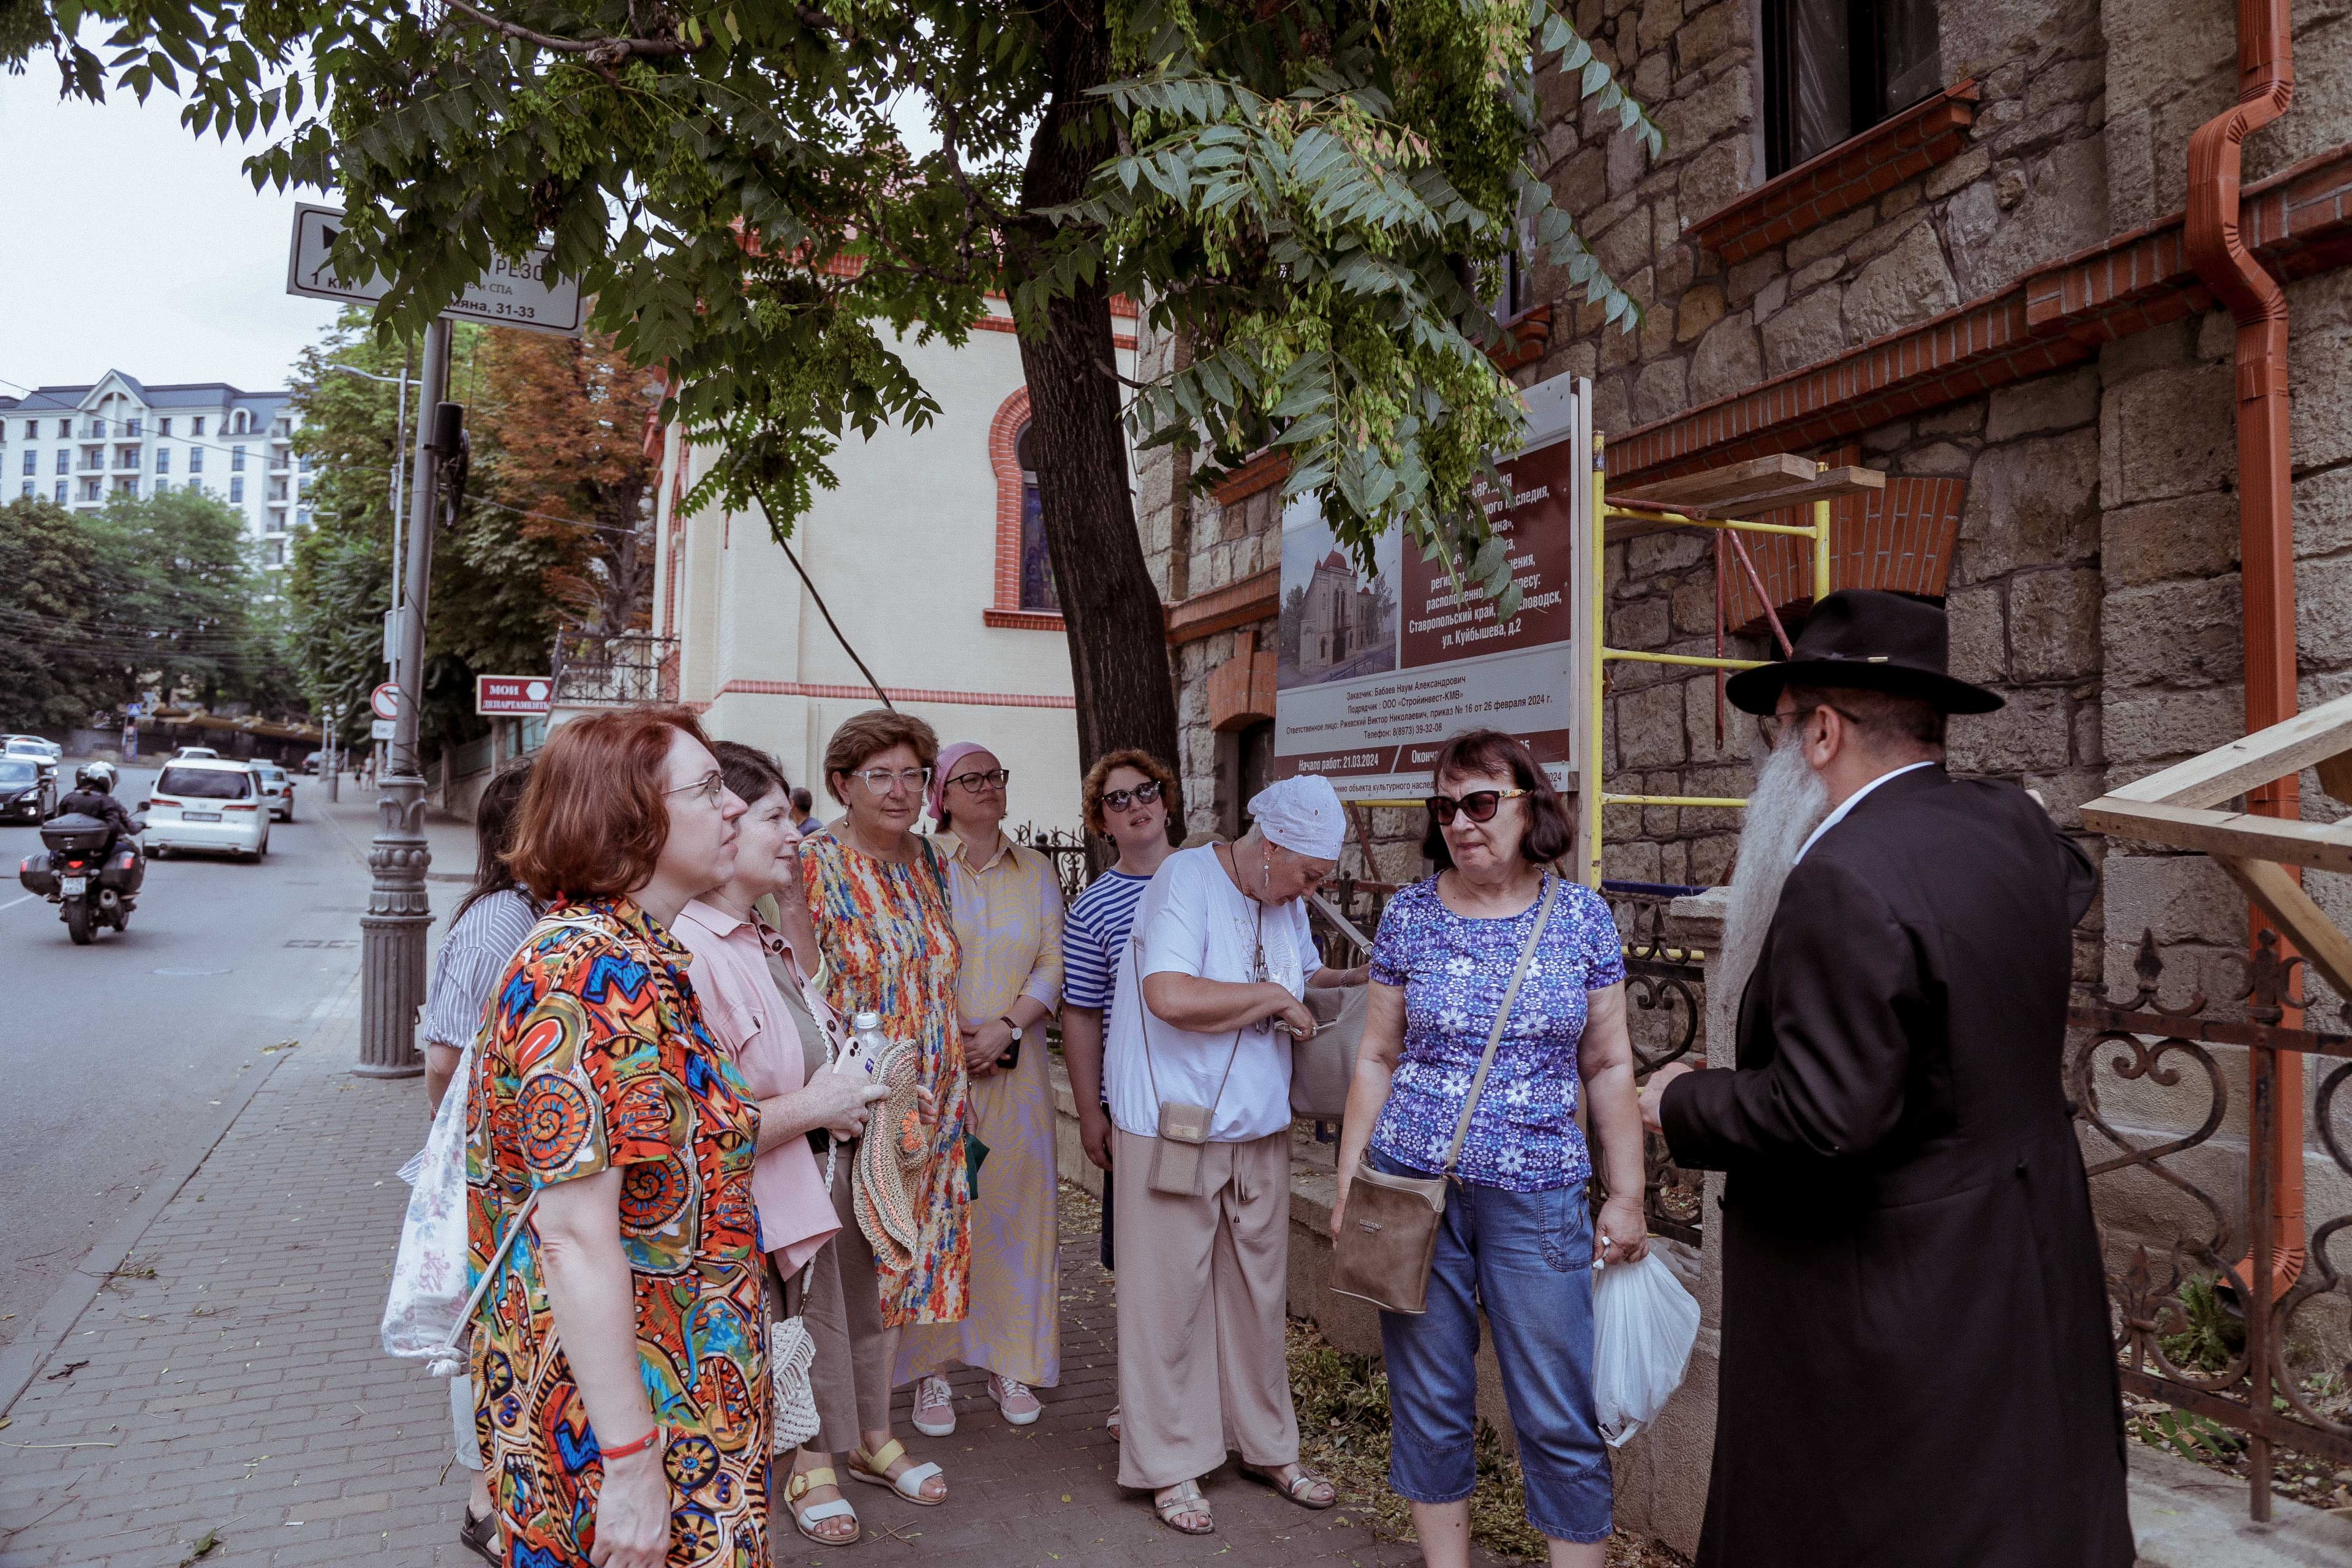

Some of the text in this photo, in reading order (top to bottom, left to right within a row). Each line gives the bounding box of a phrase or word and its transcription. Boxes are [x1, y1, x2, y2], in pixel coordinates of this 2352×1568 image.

[311, 272, 318, 285] 1
[490, 284, 513, 295] СПА
[496, 303, 535, 318] 31-33
[1506, 485, 1550, 510] нследия,
[1409, 590, 1562, 634] Ставропольский край, словодск,
[1442, 617, 1521, 649] ул. Куйбышева, д.2
[1347, 676, 1466, 701] Заказчик: Бабаев Наум Александрович
[1348, 703, 1378, 714] Подрядчик
[1382, 699, 1396, 709] ООО
[1398, 690, 1463, 709] «Стройинвест-КМВ»
[1286, 725, 1324, 735] Ответственное
[1340, 717, 1366, 728] Ржевский
[1368, 715, 1388, 726] Виктор
[1389, 711, 1428, 722] Николаевич,
[1430, 709, 1453, 720] приказ
[1455, 706, 1463, 715] №
[1465, 704, 1472, 714] 16
[1474, 704, 1482, 712] от
[1484, 701, 1492, 711] 26
[1494, 699, 1526, 712] февраля
[1528, 695, 1545, 706] 2024
[1547, 695, 1552, 704] г.
[1364, 722, 1442, 739] Телефон: 8(8973) 39-32-08
[1298, 759, 1321, 772] Начало
[1322, 757, 1342, 772] работ:
[1343, 753, 1379, 769] 21.03.2024
[1349, 784, 1371, 793] объекта
[1373, 781, 1410, 794] культурного
